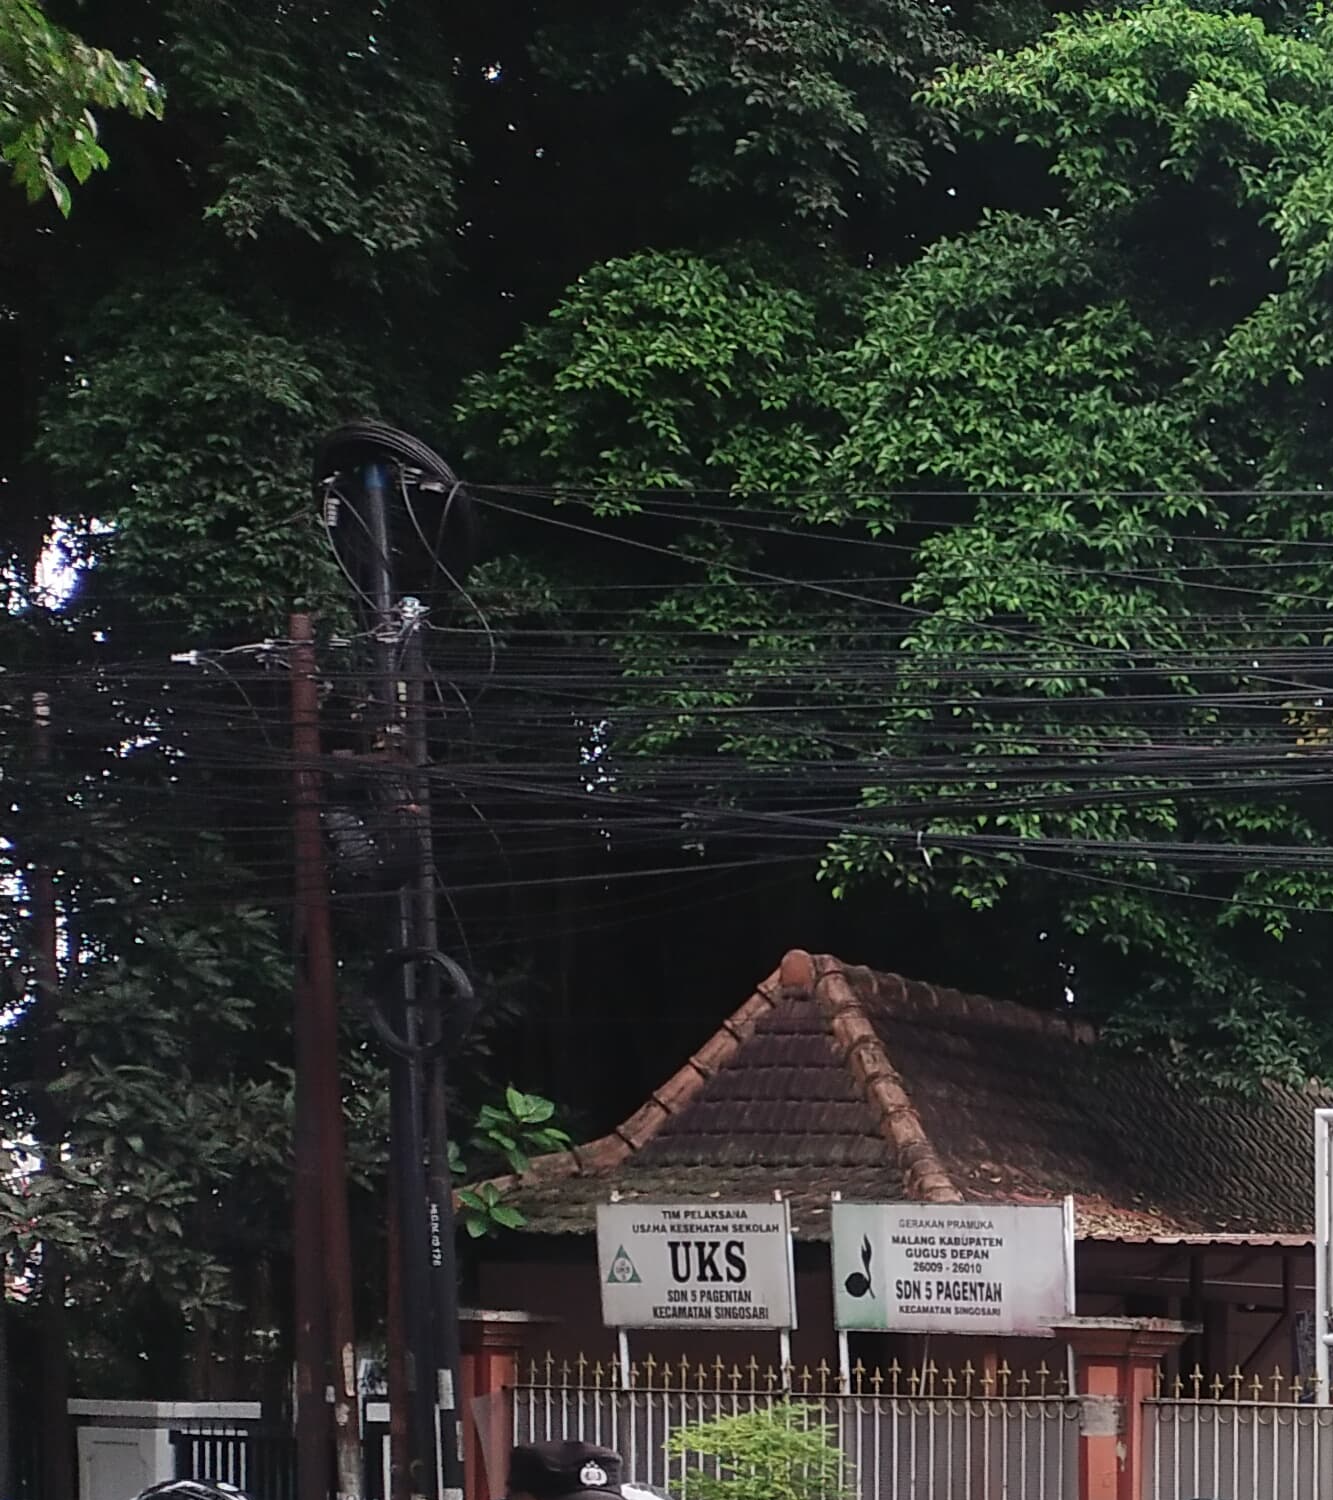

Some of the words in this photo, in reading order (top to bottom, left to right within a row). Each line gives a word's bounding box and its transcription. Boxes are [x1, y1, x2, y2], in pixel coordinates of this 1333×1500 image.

[661, 1210, 681, 1219] TIM
[684, 1210, 748, 1219] PELAKSANA
[632, 1224, 667, 1233] USAHA
[670, 1224, 729, 1233] KESEHATAN
[732, 1224, 780, 1233] SEKOLAH
[899, 1219, 944, 1229] GERAKAN
[947, 1220, 994, 1230] PRAMUKA
[892, 1236, 936, 1246] MALANG
[939, 1236, 1003, 1247] KABUPATEN
[905, 1248, 947, 1259] GUGUS
[951, 1249, 989, 1259] DEPAN
[667, 1240, 747, 1283] UKS
[952, 1263, 982, 1274] 26010
[895, 1279, 921, 1300] SDN
[925, 1281, 932, 1300] 5
[937, 1281, 1002, 1302] PAGENTAN
[667, 1290, 688, 1303] SDN
[691, 1290, 698, 1302] 5
[701, 1290, 752, 1303] PAGENTAN
[652, 1306, 712, 1319] KECAMATAN
[715, 1306, 769, 1319] SINGOSARI
[899, 1305, 951, 1315] KECAMATAN
[954, 1306, 1001, 1316] SINGOSARI
